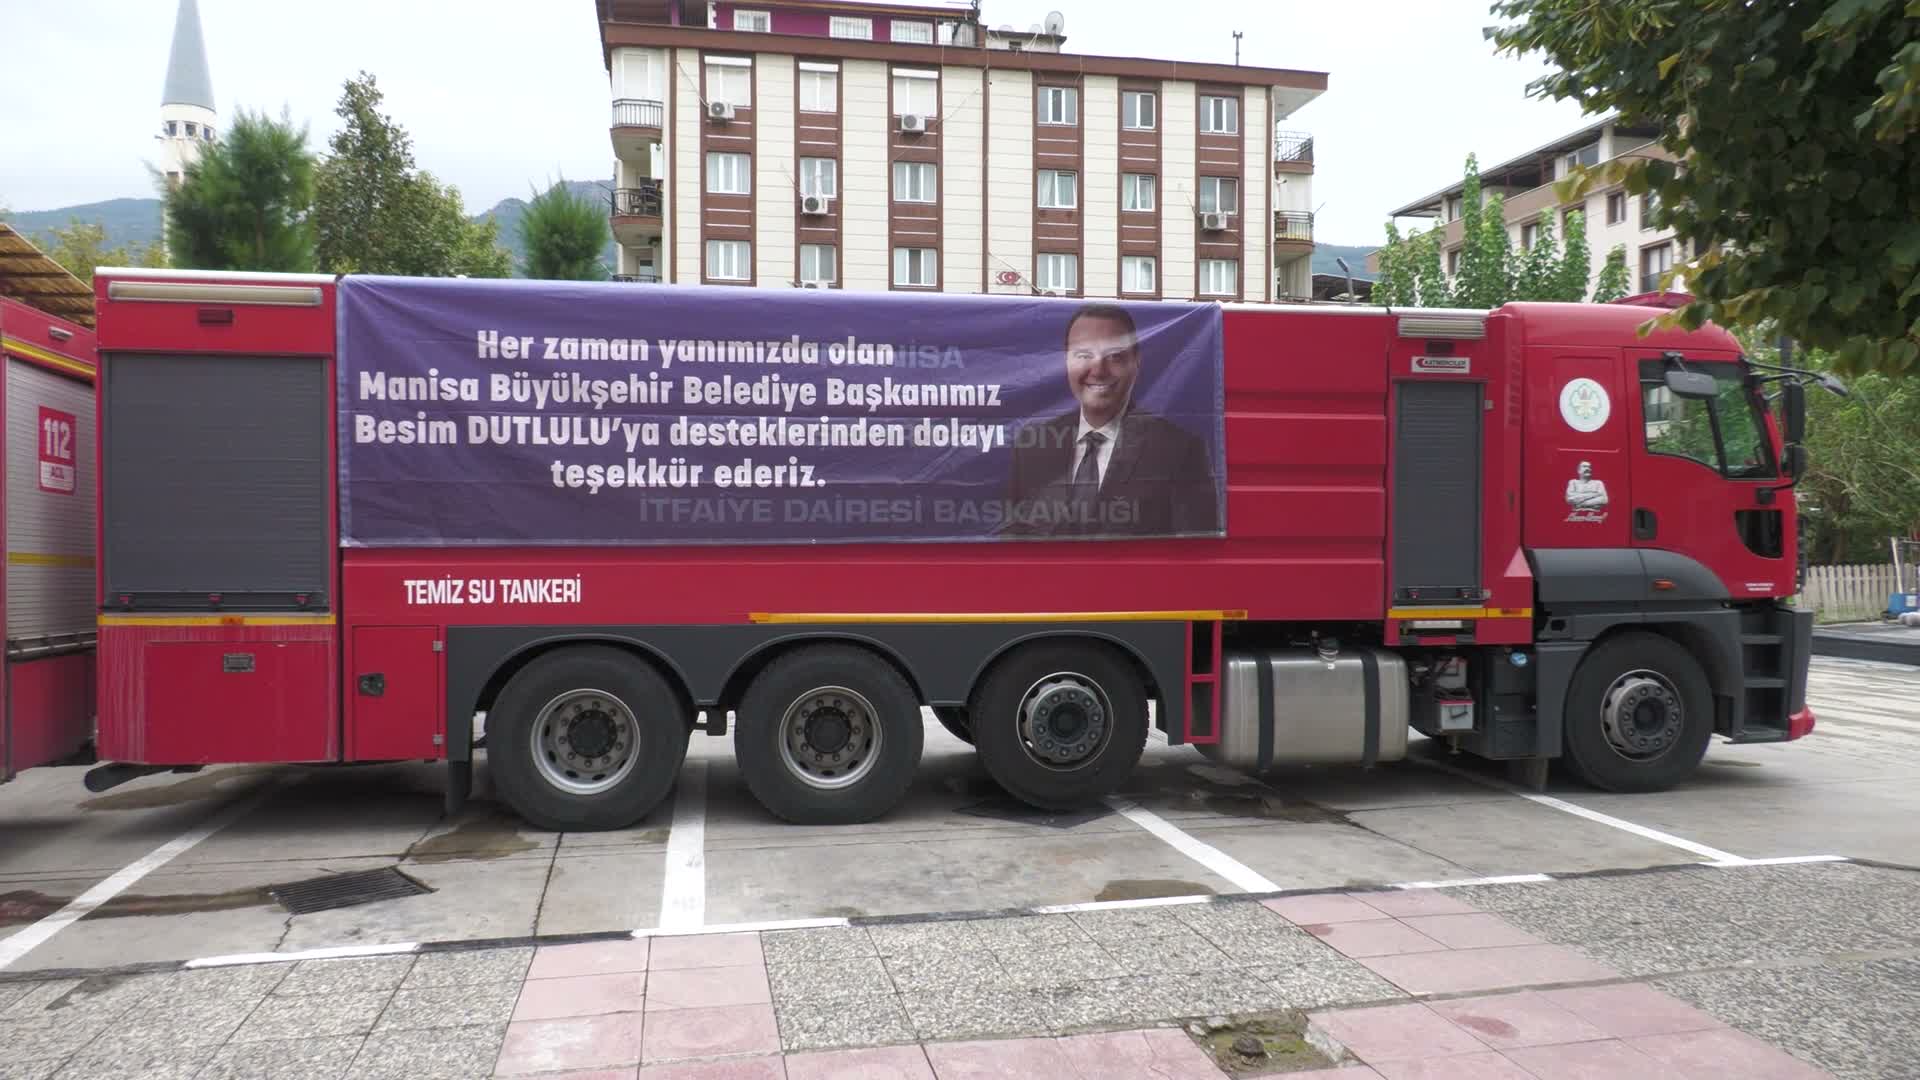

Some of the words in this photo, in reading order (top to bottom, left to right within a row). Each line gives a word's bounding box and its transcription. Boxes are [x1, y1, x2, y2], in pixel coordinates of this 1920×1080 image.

[478, 331, 534, 359] Her
[544, 338, 649, 361] zaman
[659, 335, 818, 368] yanımızda
[828, 336, 895, 365] olan
[360, 368, 478, 401] Manisa
[491, 372, 672, 409] Büyükşehir
[684, 373, 816, 411] Belediye
[827, 377, 1001, 411] Başkanımız
[44, 418, 71, 459] 112
[356, 412, 456, 444] Besim
[671, 416, 904, 446] desteklerinden
[914, 418, 1004, 452] dolayı
[551, 458, 703, 493] teşekkür
[714, 457, 826, 487] ederiz.
[640, 494, 772, 523] İTFAİYE
[404, 574, 465, 605] TEMİZ
[469, 580, 495, 604] SU
[500, 573, 581, 604] TANKERİ
